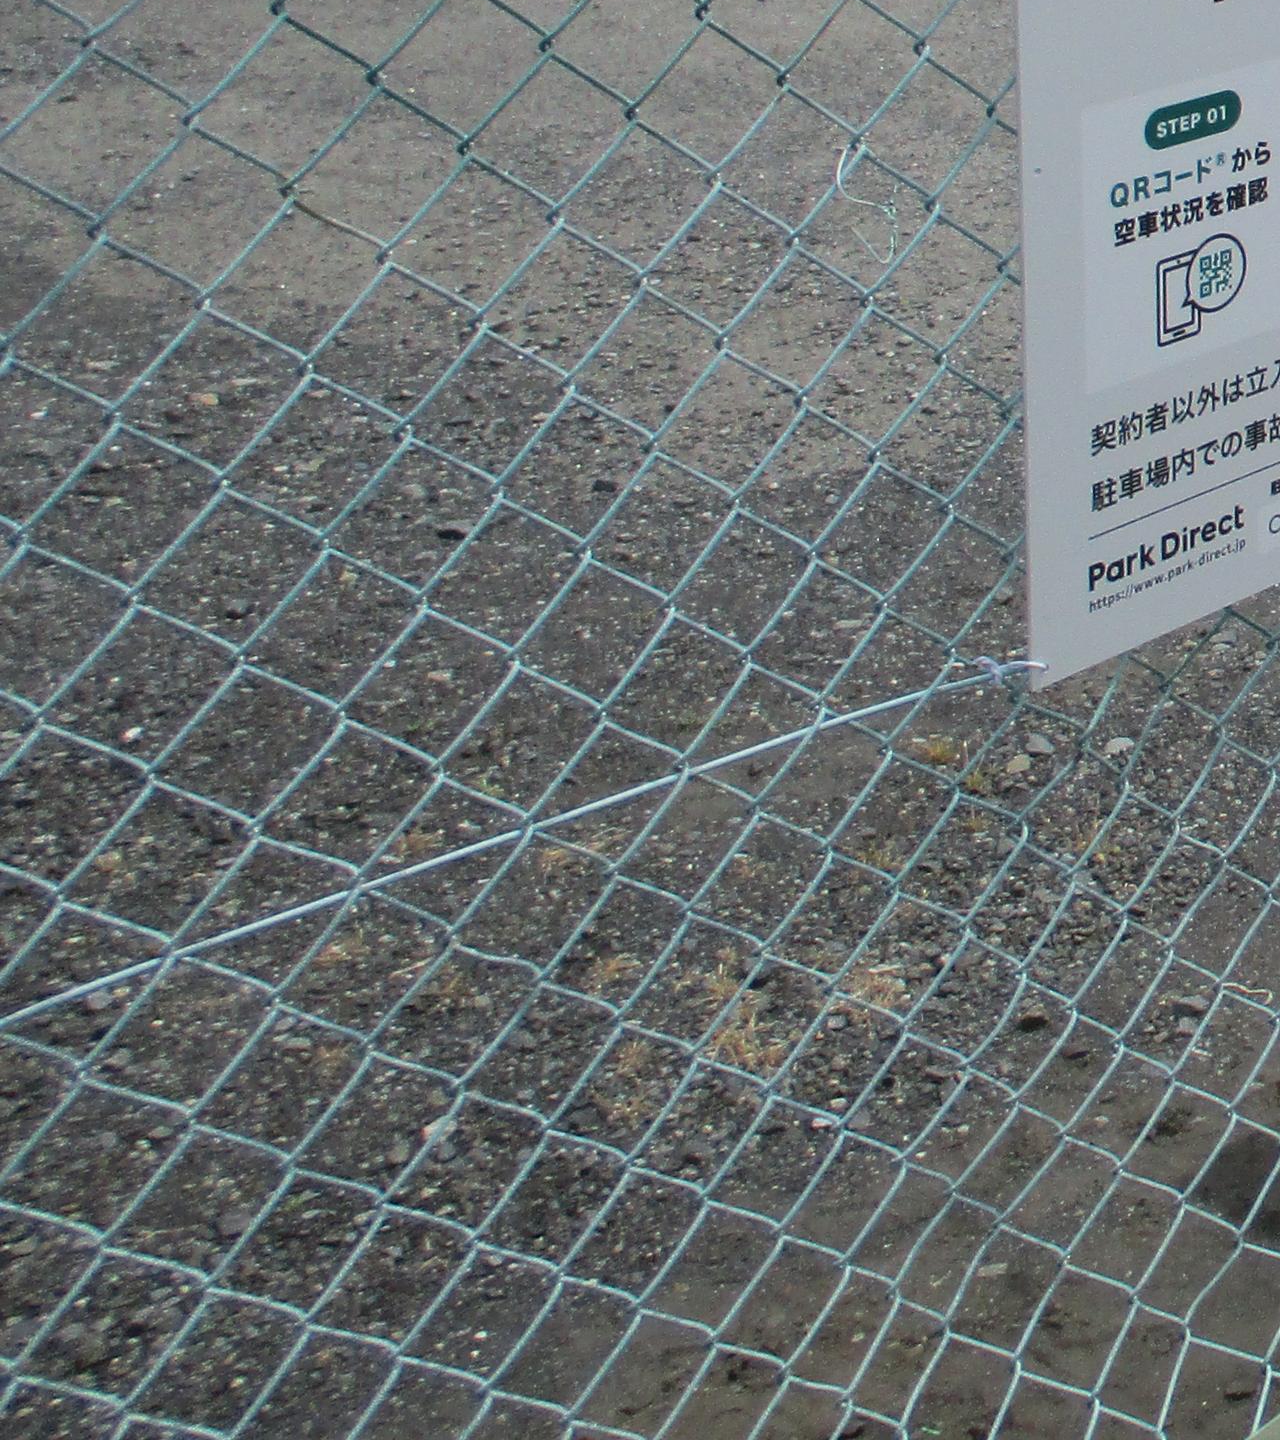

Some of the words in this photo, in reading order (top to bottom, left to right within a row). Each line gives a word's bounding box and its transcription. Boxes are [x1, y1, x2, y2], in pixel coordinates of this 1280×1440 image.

[1157, 112, 1201, 139] STEP
[1207, 104, 1227, 124] 01
[1114, 176, 1269, 248] 空車状況を確認
[1088, 543, 1156, 592] Park
[1161, 505, 1245, 561] Direct
